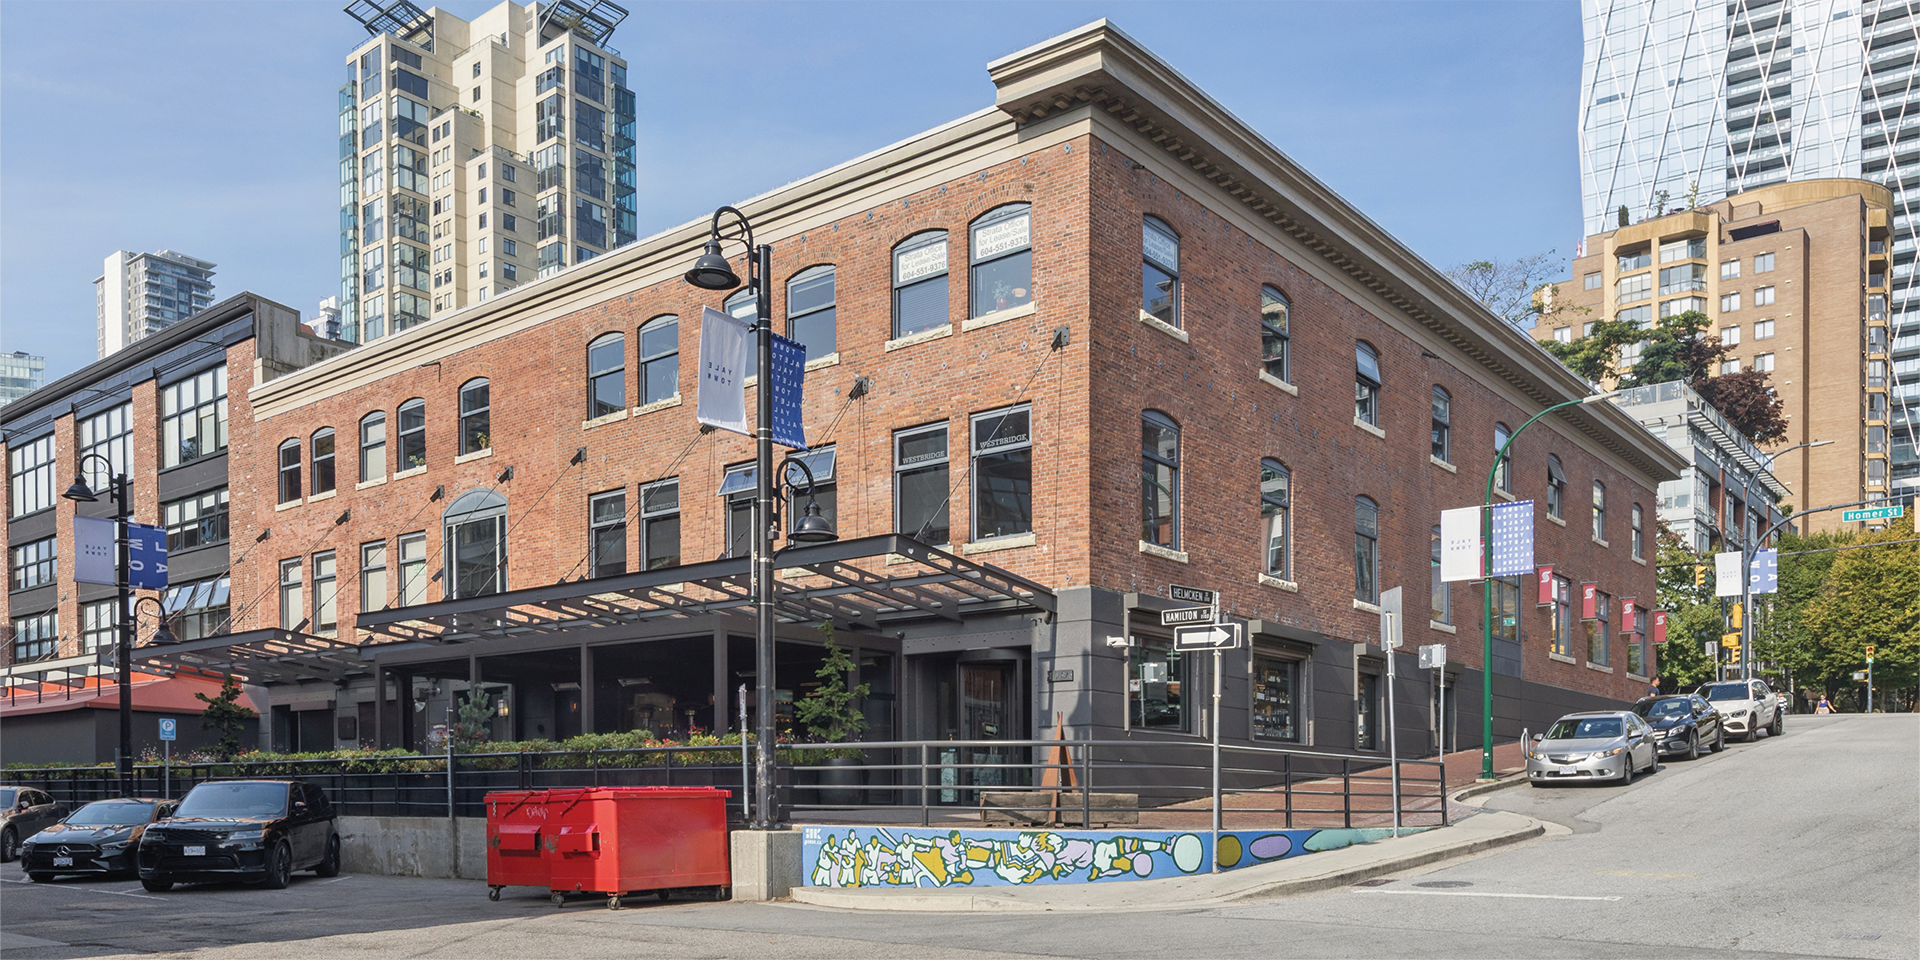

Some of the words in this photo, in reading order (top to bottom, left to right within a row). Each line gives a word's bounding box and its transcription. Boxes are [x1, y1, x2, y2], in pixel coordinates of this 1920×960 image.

[982, 225, 1002, 238] Strata
[1004, 218, 1024, 230] Office
[978, 238, 988, 246] for
[980, 235, 1028, 256] 604-551-9376
[904, 250, 923, 262] Strata
[924, 245, 942, 256] Office
[901, 262, 910, 271] for
[902, 260, 946, 280] 604-551-9376
[980, 434, 1027, 449] WESTBRIDGE
[902, 451, 945, 464] WESTBRIDGE
[1848, 510, 1883, 520] Homer
[1888, 508, 1897, 516] St
[1174, 588, 1203, 601] HELMCKEN
[1166, 610, 1198, 622] HAMILTON
